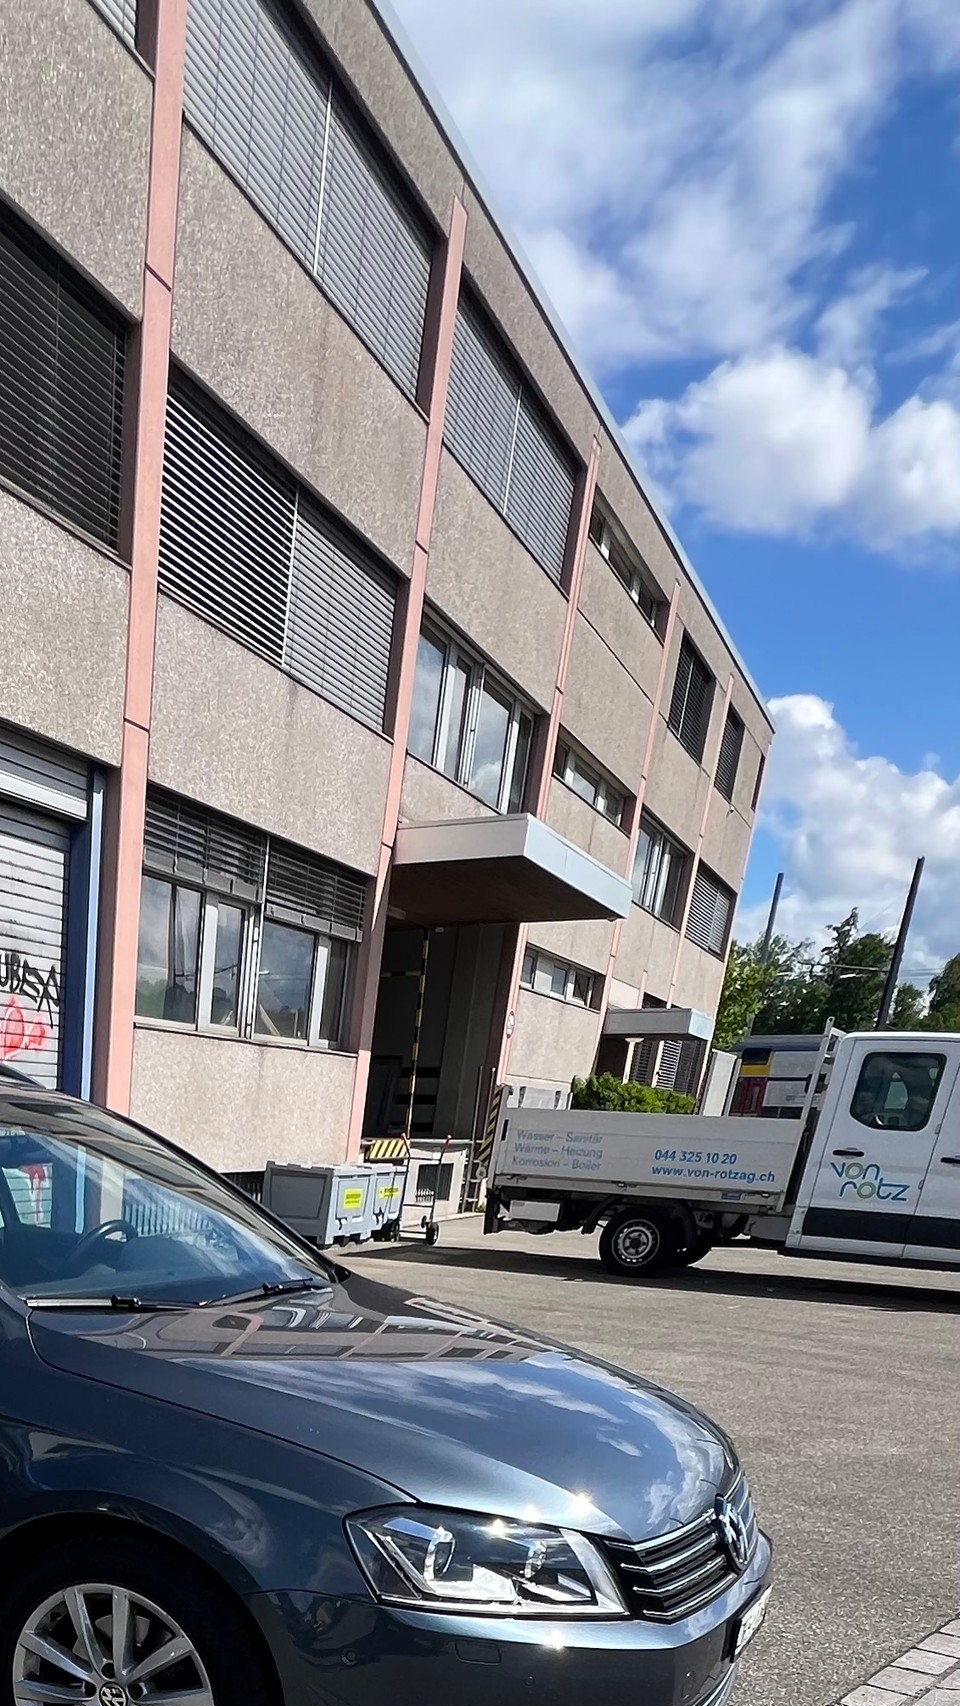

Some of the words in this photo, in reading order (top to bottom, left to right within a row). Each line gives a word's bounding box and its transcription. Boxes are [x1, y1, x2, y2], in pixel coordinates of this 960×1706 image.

[516, 1129, 555, 1141] Wasser
[512, 1155, 560, 1168] Korrosion
[654, 1149, 676, 1161] 044
[679, 1150, 702, 1163] 325
[706, 1152, 719, 1164] 10
[720, 1153, 738, 1165] 20
[651, 1165, 775, 1184] www.von-rotzag.ch
[830, 1162, 880, 1180] von
[839, 1177, 911, 1201] rotz
